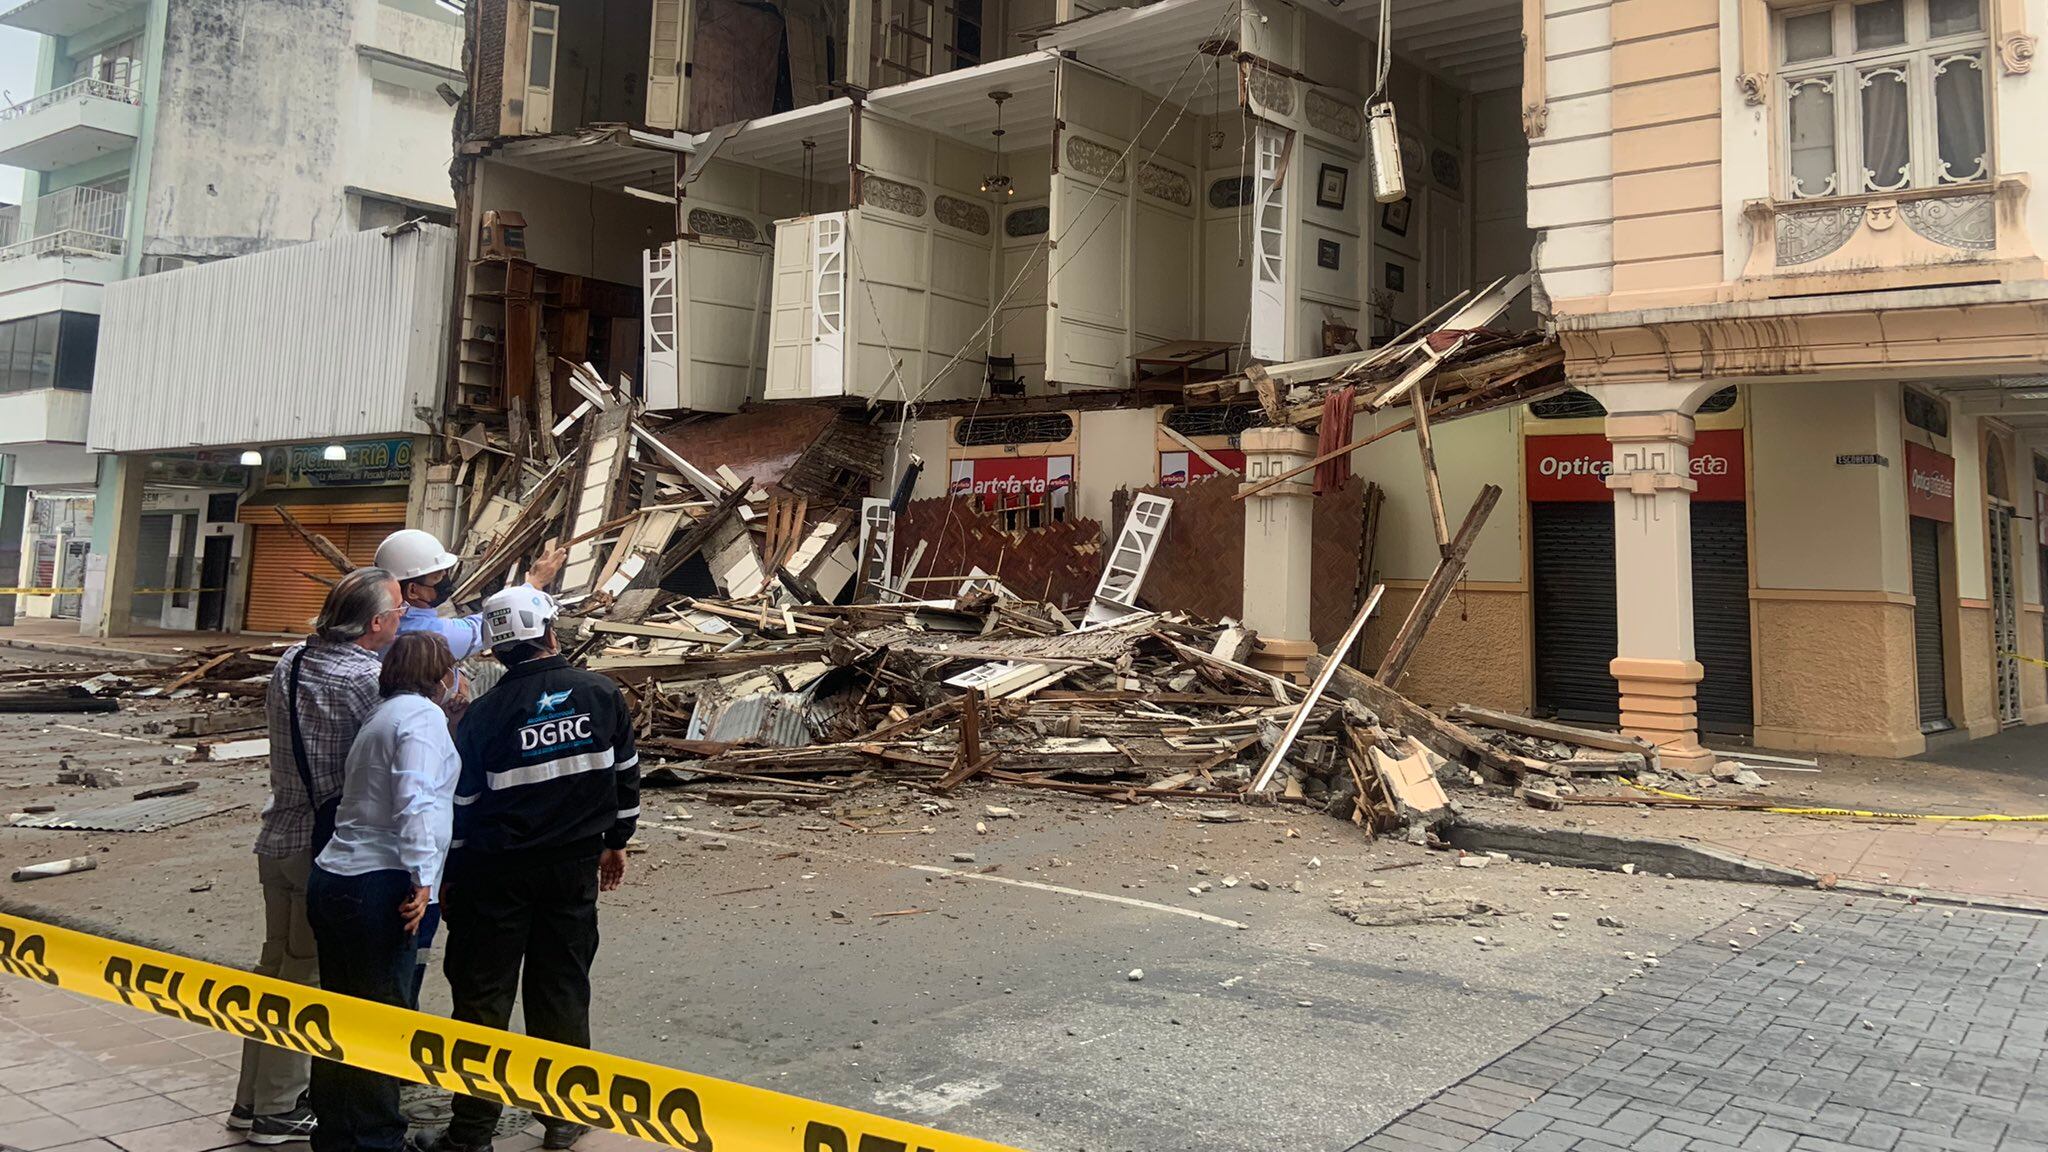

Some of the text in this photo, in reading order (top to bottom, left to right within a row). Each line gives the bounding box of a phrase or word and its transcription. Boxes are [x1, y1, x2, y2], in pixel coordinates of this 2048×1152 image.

[1539, 455, 1613, 480] Optica
[520, 716, 592, 750] DGRC
[104, 956, 344, 1061] PELIGRO
[410, 1029, 713, 1152] PELIGRO
